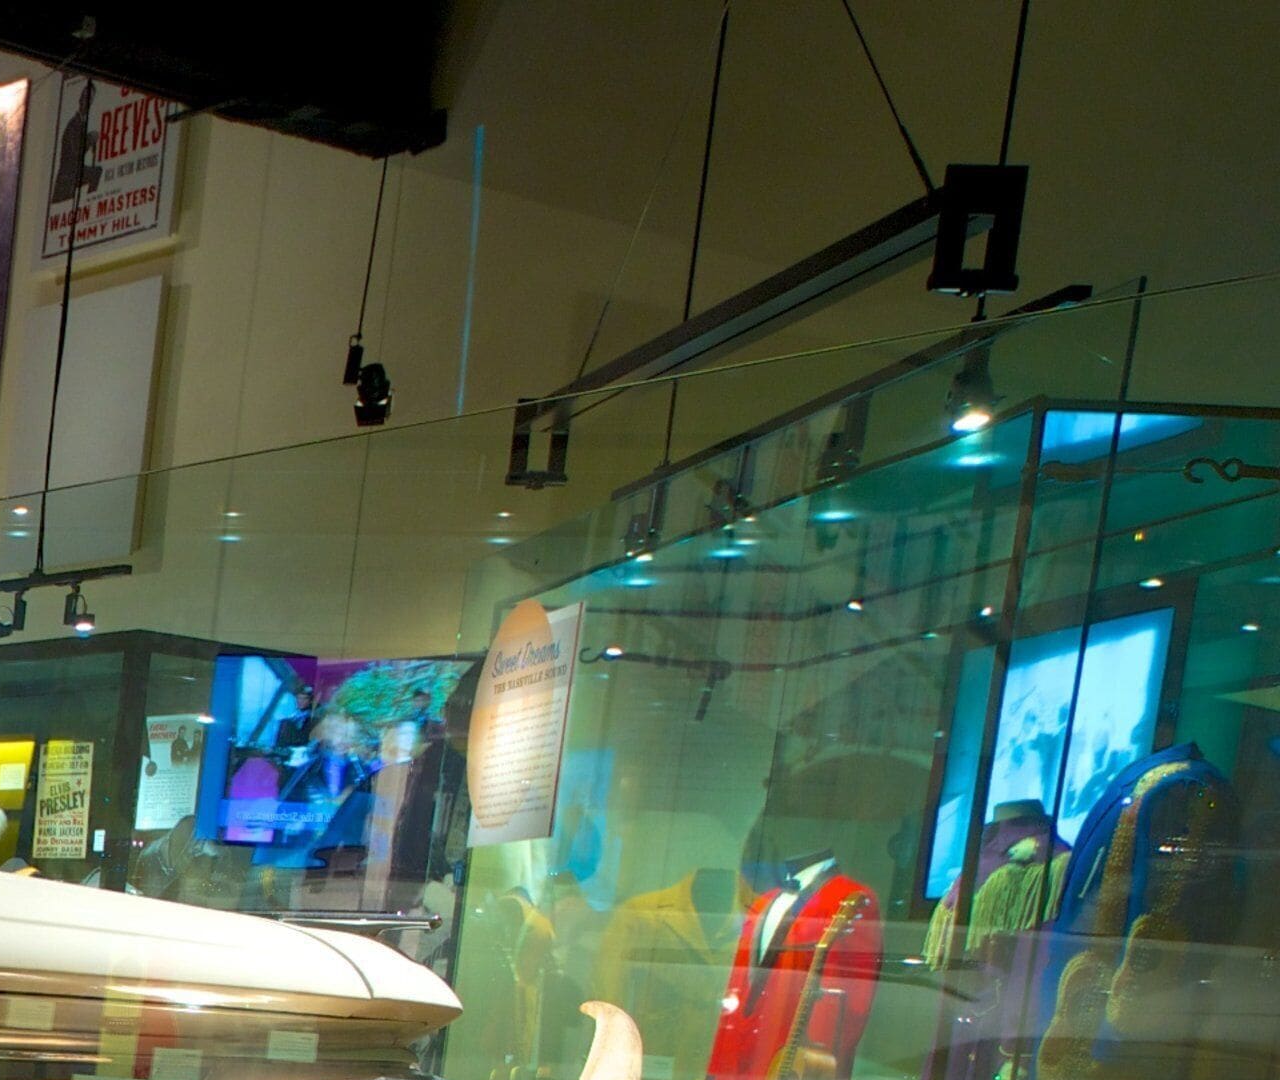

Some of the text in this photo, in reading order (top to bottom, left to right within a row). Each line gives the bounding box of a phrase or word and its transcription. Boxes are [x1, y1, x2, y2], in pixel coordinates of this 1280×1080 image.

[97, 98, 165, 162] REEVES
[49, 204, 90, 231] WAGON
[96, 185, 157, 217] MASTERS
[58, 213, 140, 248] TOMMY HILL
[39, 790, 86, 817] PRESLEY
[50, 782, 71, 797] ELVIS
